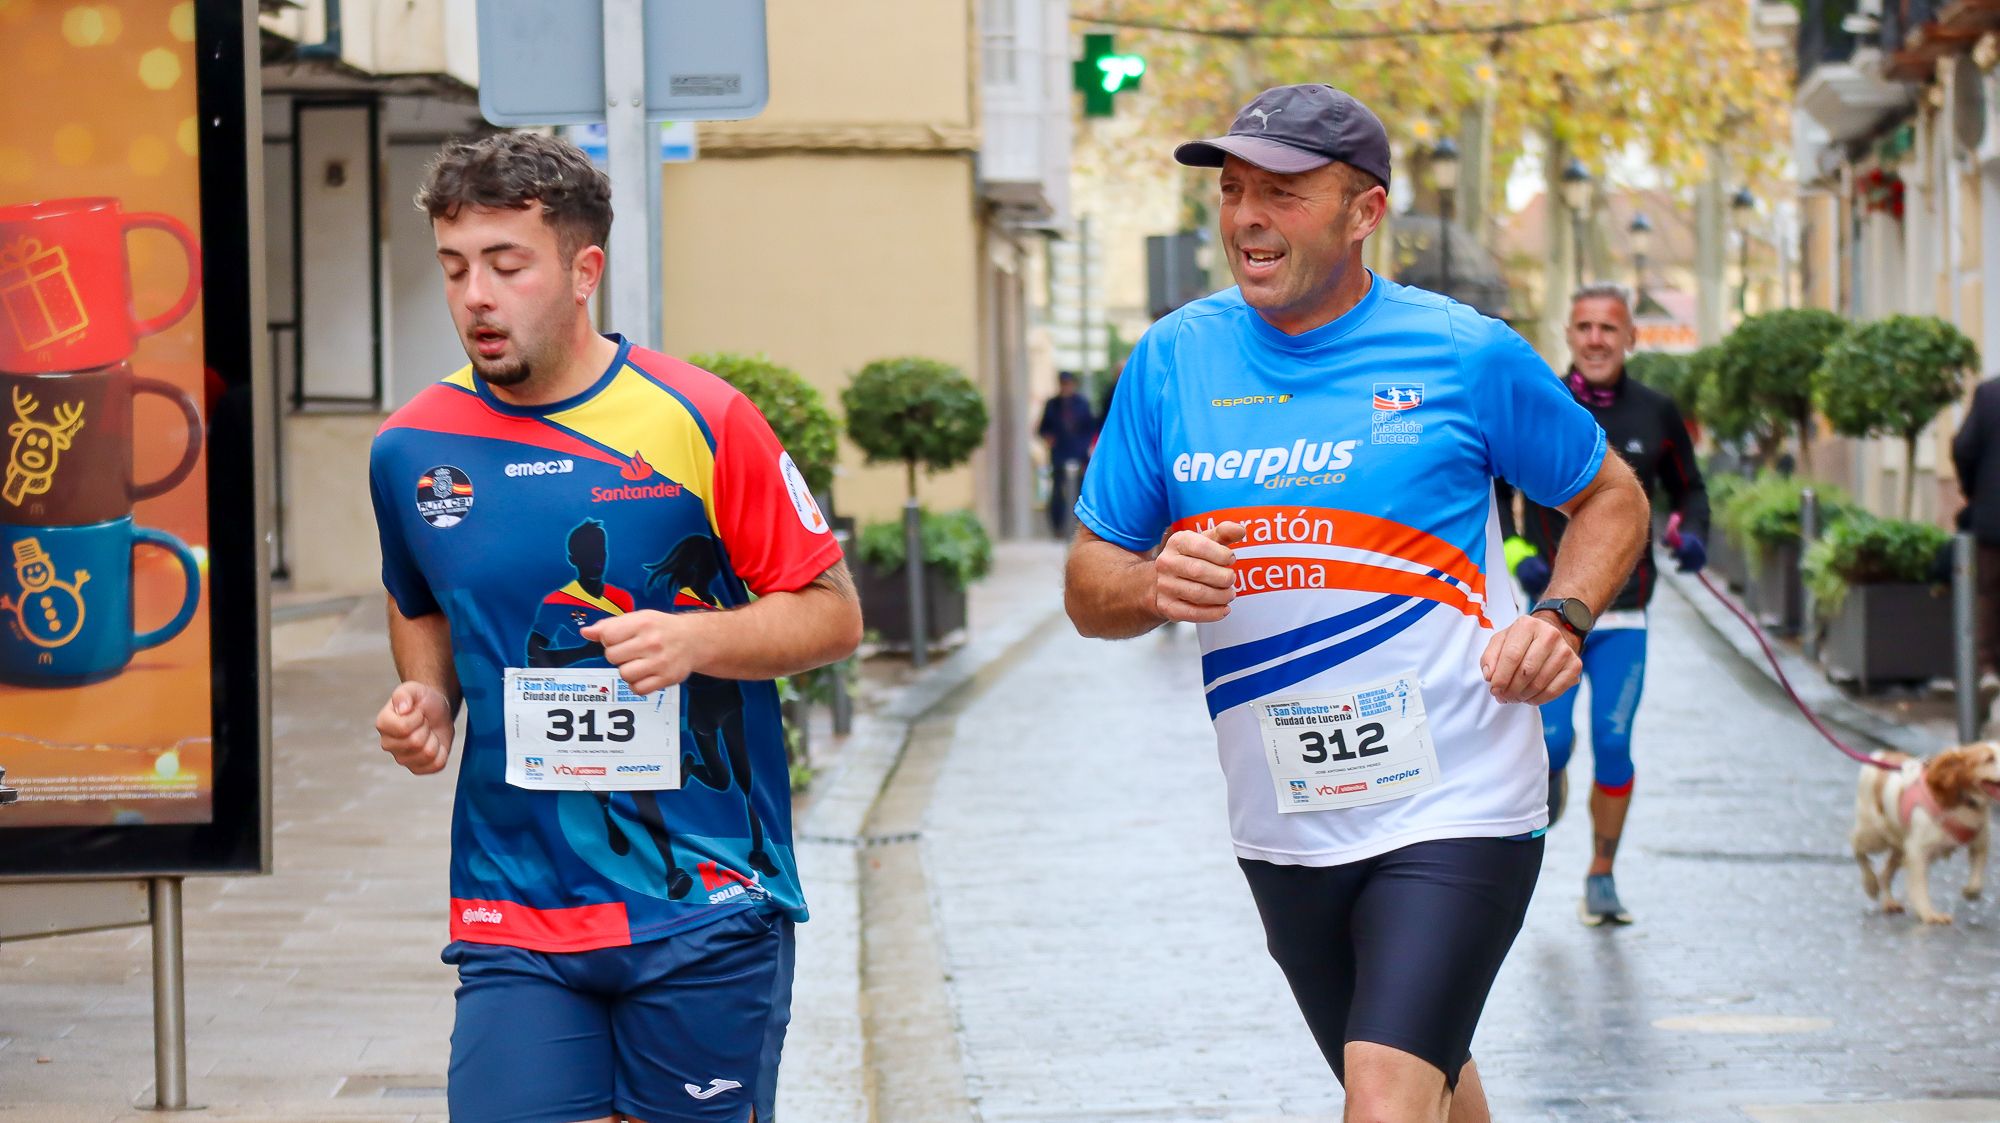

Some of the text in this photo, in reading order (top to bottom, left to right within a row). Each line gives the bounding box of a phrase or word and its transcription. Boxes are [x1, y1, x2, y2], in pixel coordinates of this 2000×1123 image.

[1211, 394, 1275, 407] GSPORT
[1372, 411, 1401, 423] Club
[1372, 421, 1422, 434] Maratón
[1371, 433, 1419, 445] Lucena
[1263, 472, 1347, 490] directo
[591, 483, 684, 503] Santander
[1195, 509, 1334, 545] Mratón
[1231, 563, 1326, 593] ucena
[523, 681, 542, 691] San
[543, 681, 587, 692] Silvestre
[523, 691, 608, 702] Ciudad de Lucena
[1357, 688, 1388, 700] MEMORIAL
[1372, 691, 1395, 702] CARLOS
[1273, 707, 1290, 717] San
[1291, 705, 1329, 716] Silvestre
[546, 708, 635, 743] 313
[1275, 713, 1352, 726] Ciudad de Lucena
[1299, 722, 1389, 764] 312
[616, 764, 662, 773] enerplus
[1376, 768, 1420, 784] enerplus
[1315, 784, 1338, 796] vtv
